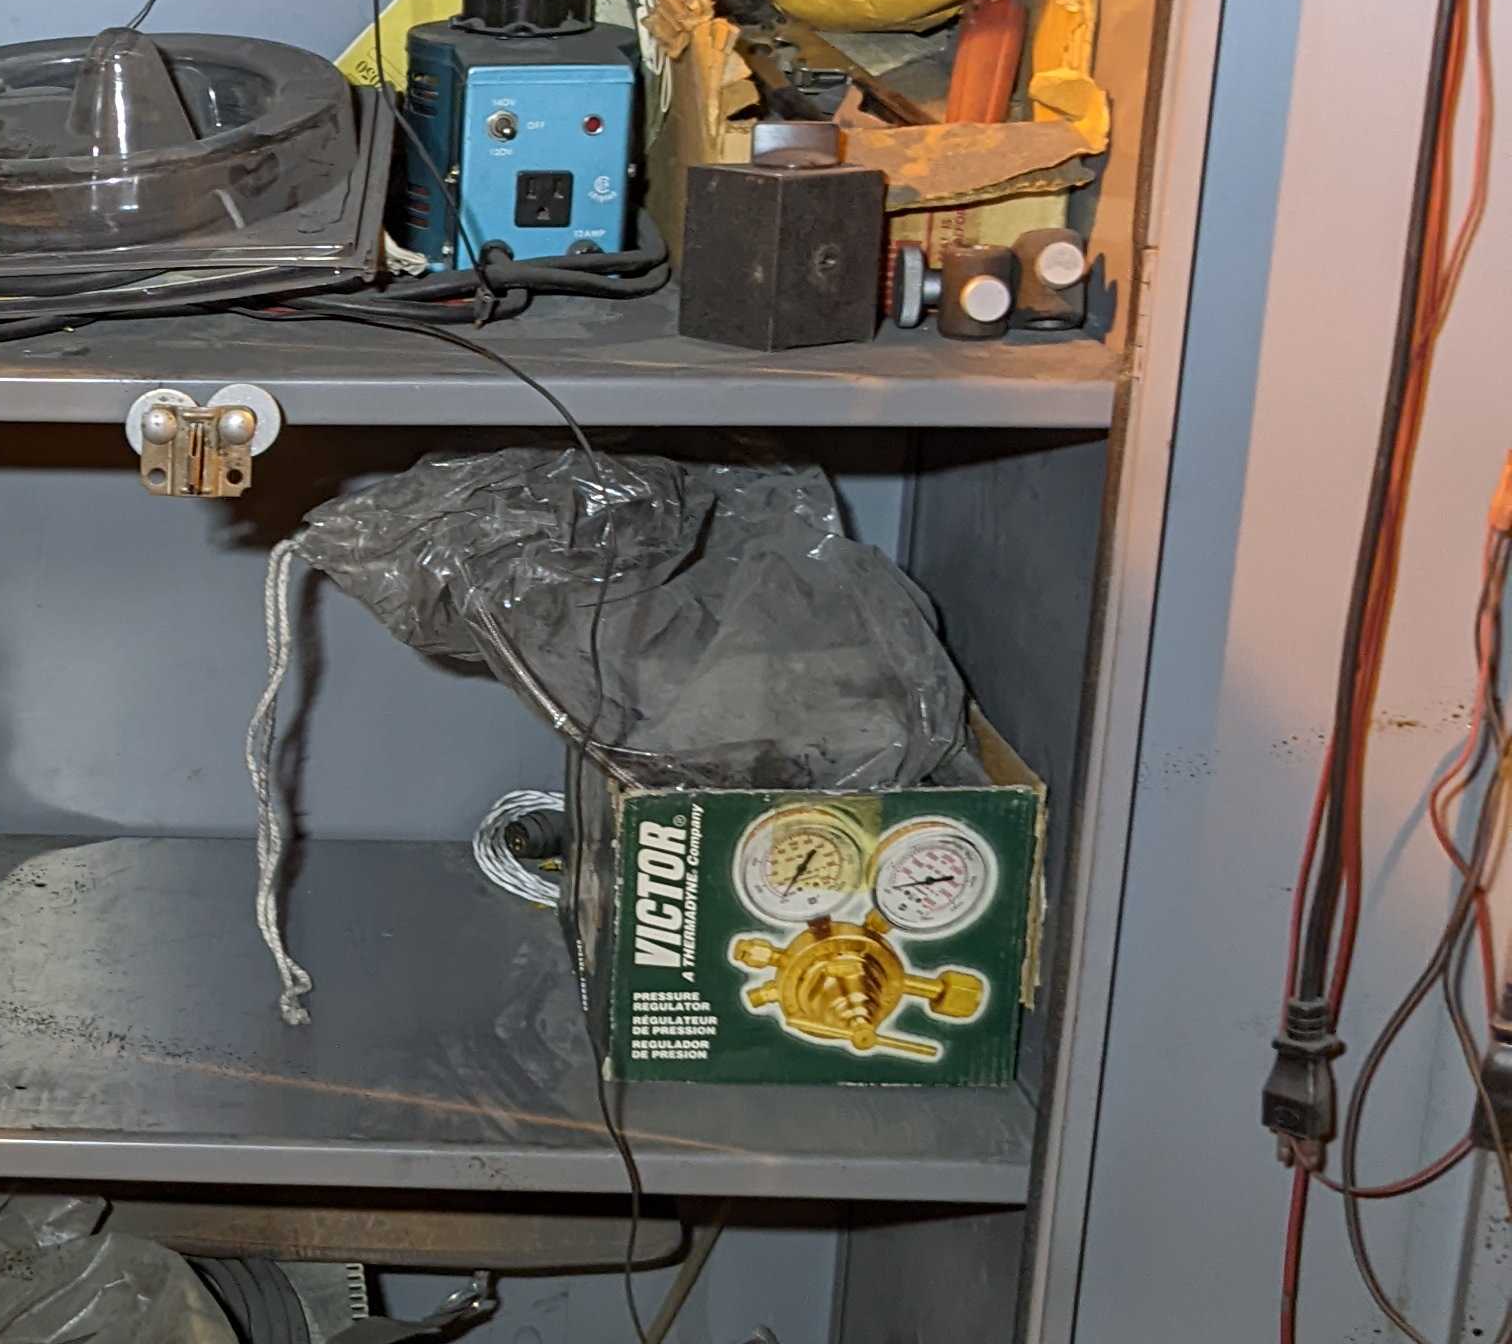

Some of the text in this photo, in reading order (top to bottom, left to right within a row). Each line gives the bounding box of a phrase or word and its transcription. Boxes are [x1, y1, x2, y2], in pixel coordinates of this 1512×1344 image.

[526, 120, 545, 130] OFF
[686, 804, 705, 866] Company
[634, 821, 687, 968] VICTOR
[681, 971, 696, 983] A
[633, 991, 701, 1003] PRESSURE
[632, 1001, 712, 1013] REGULATOR
[632, 1014, 719, 1027] RÉGULATEUR
[632, 1025, 717, 1037] DE PRESSION
[631, 1039, 710, 1050] REGULADOR
[631, 1049, 708, 1060] DE PRESION
